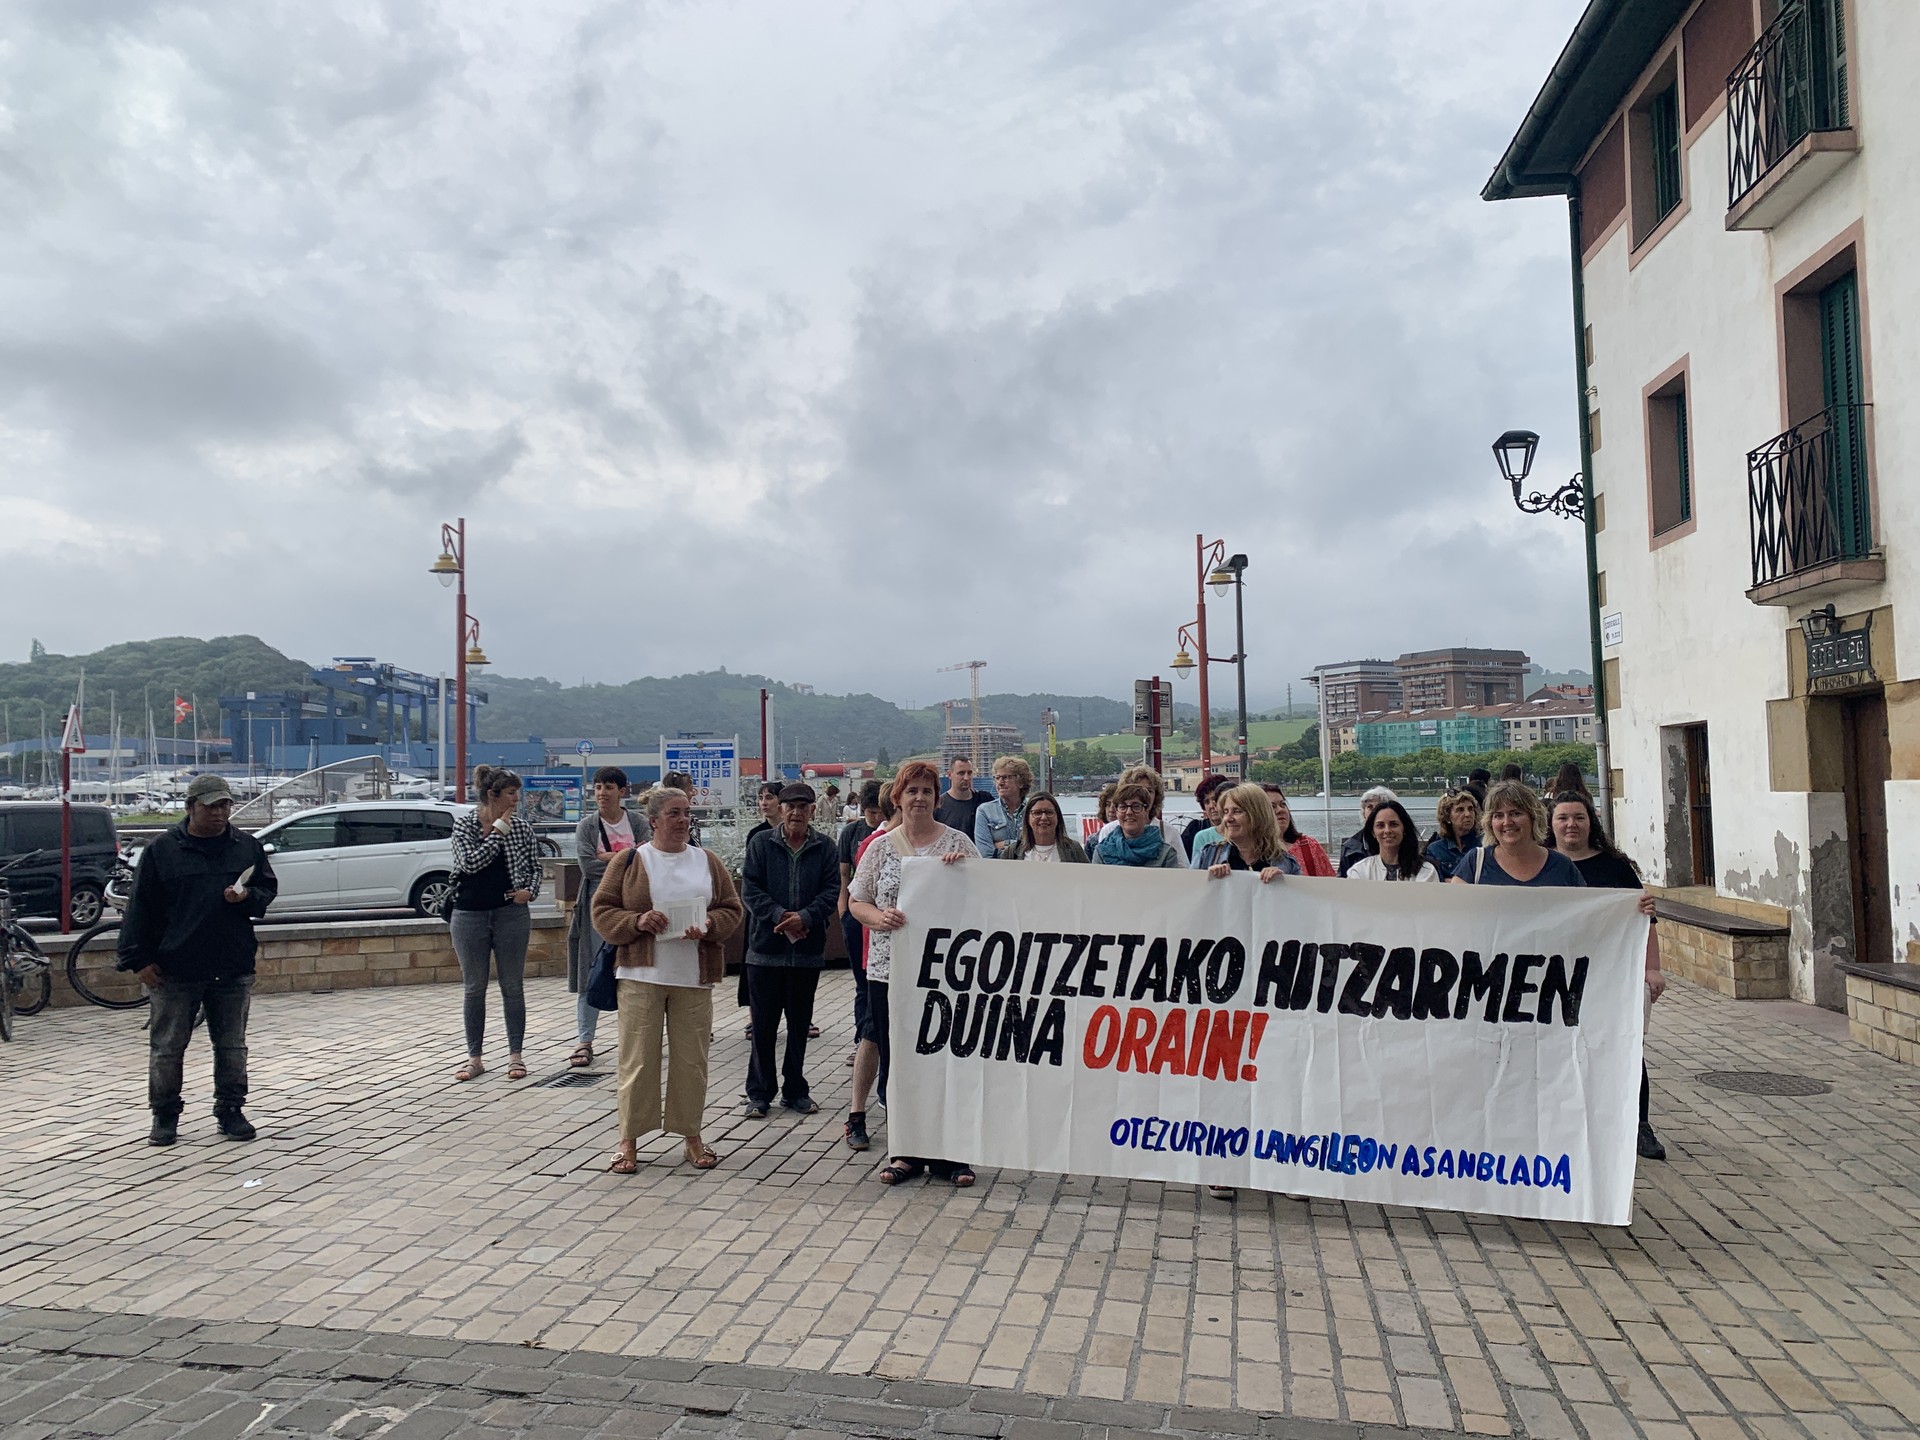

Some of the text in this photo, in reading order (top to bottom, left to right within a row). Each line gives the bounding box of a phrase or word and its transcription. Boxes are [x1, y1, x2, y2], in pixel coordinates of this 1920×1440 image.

[916, 927, 1590, 1027] EGOITZETAKO HITZARMEN
[915, 989, 1270, 1082] DUINA ORAIN!
[1109, 1116, 1572, 1194] OTEZURIKO LANGILEON ASANBLADA
